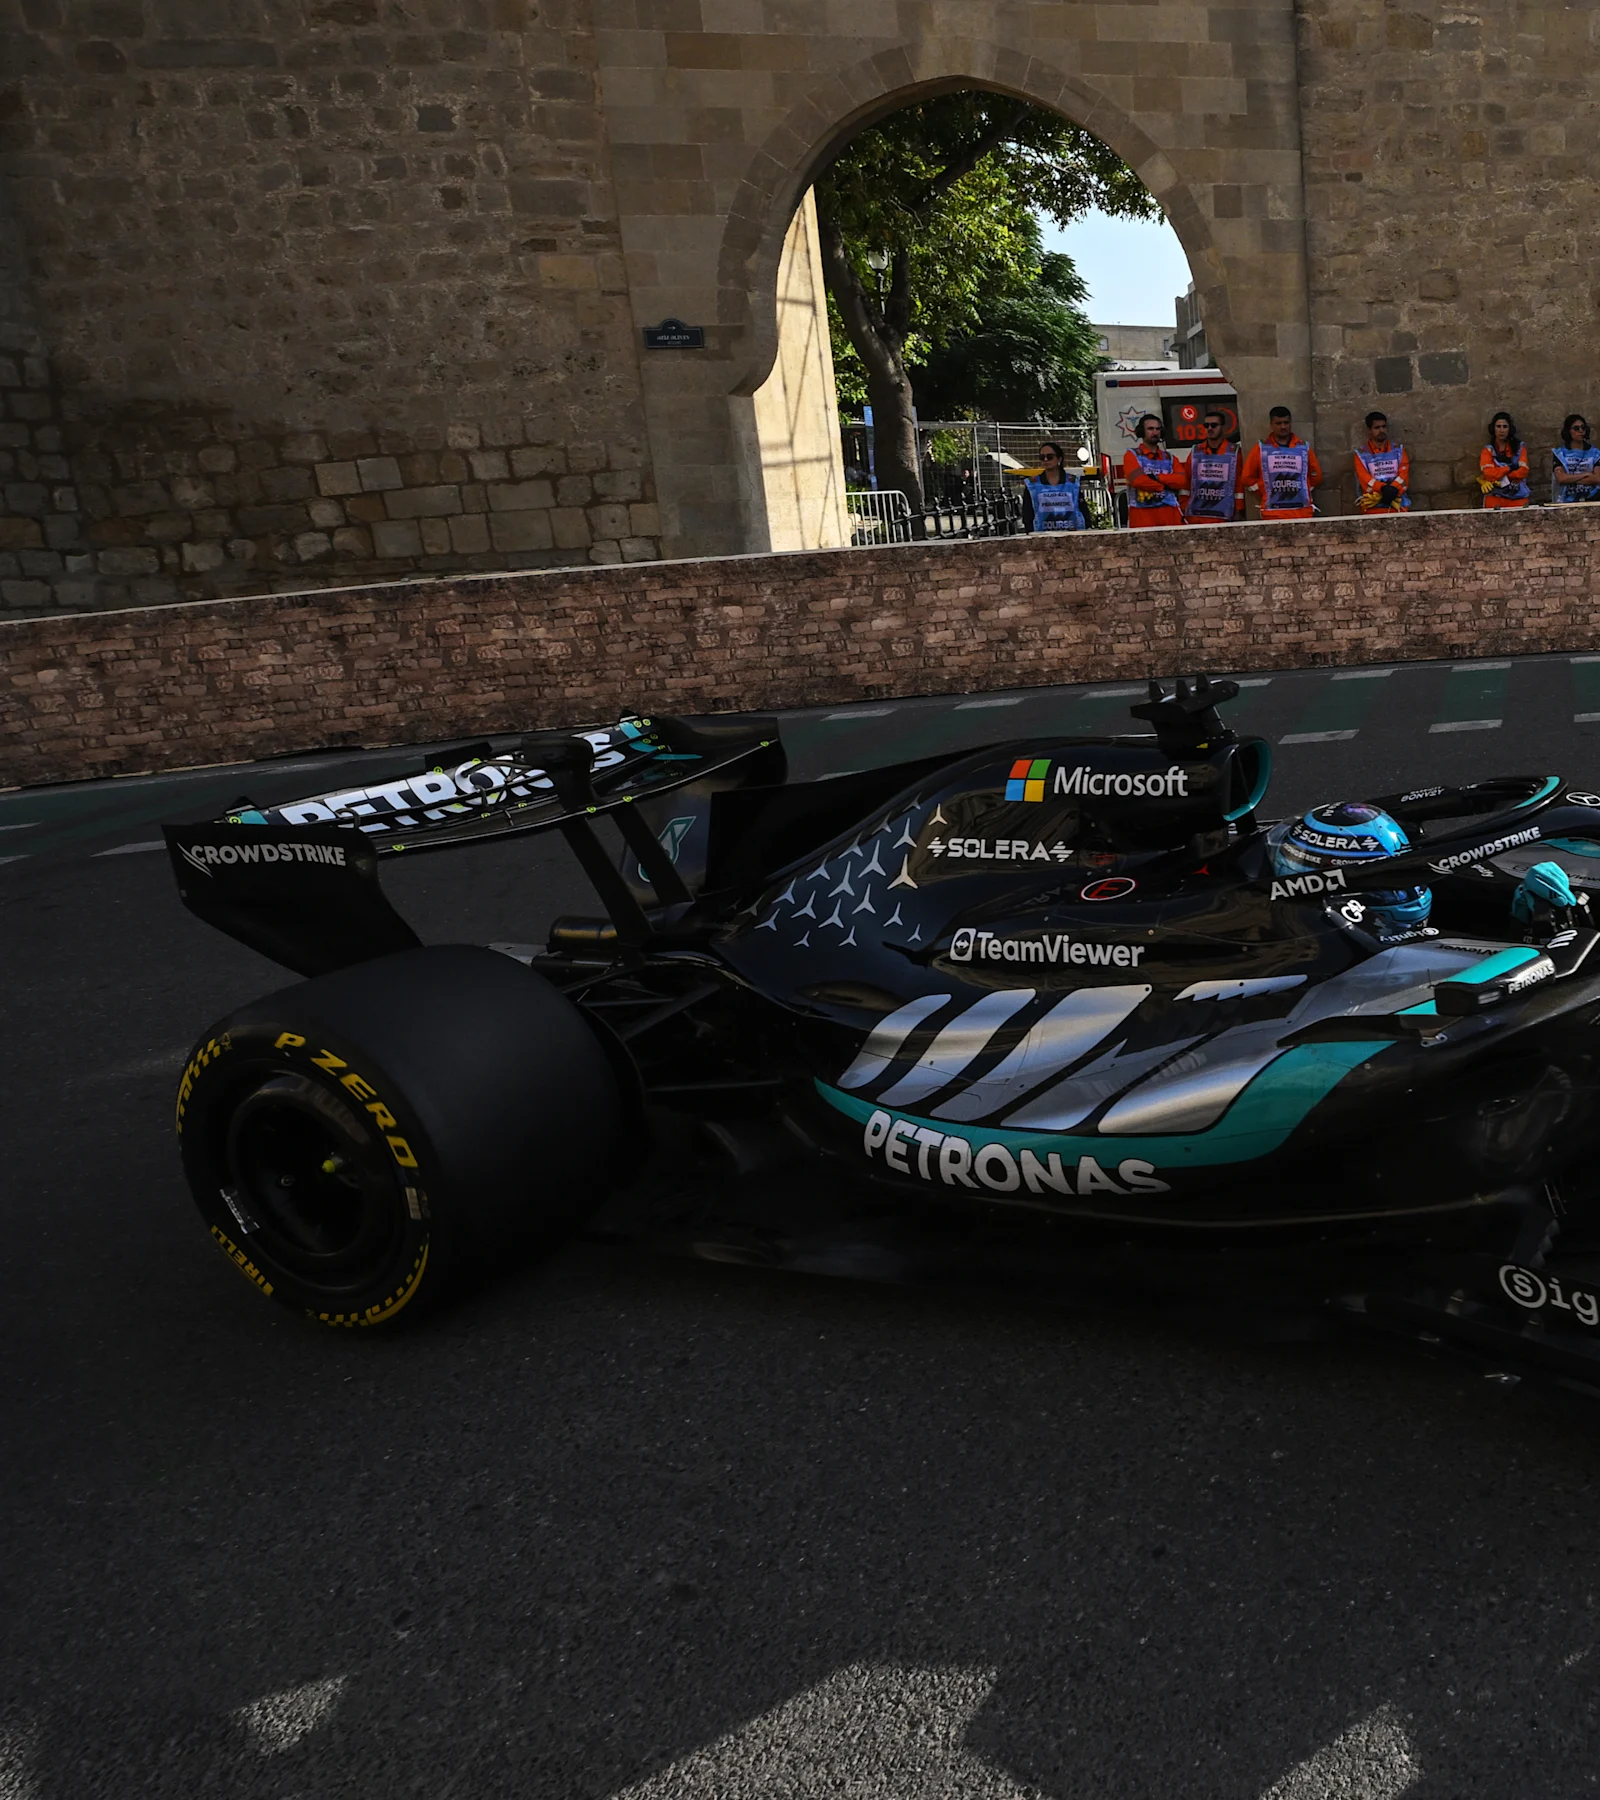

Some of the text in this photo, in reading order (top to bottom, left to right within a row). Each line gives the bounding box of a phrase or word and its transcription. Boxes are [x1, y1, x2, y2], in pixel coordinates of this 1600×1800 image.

[1176, 424, 1208, 441] 103
[1271, 479, 1302, 488] COURSE
[1042, 520, 1075, 530] COURSE
[278, 733, 627, 834] PETRONS
[1053, 766, 1188, 797] Microsoft
[190, 842, 346, 867] CROWDSTRIKE
[947, 838, 1051, 861] SOLERA
[1300, 829, 1362, 850] SOLERA
[1438, 825, 1542, 870] CROWDSTRIKE
[1270, 874, 1326, 901] AMD
[980, 931, 1145, 967] TeamViewer
[1508, 964, 1555, 994] PETRONAS
[273, 1031, 420, 1169] P ZERO
[863, 1109, 1172, 1196] PETRONAS
[211, 1224, 276, 1297] PIRELLI
